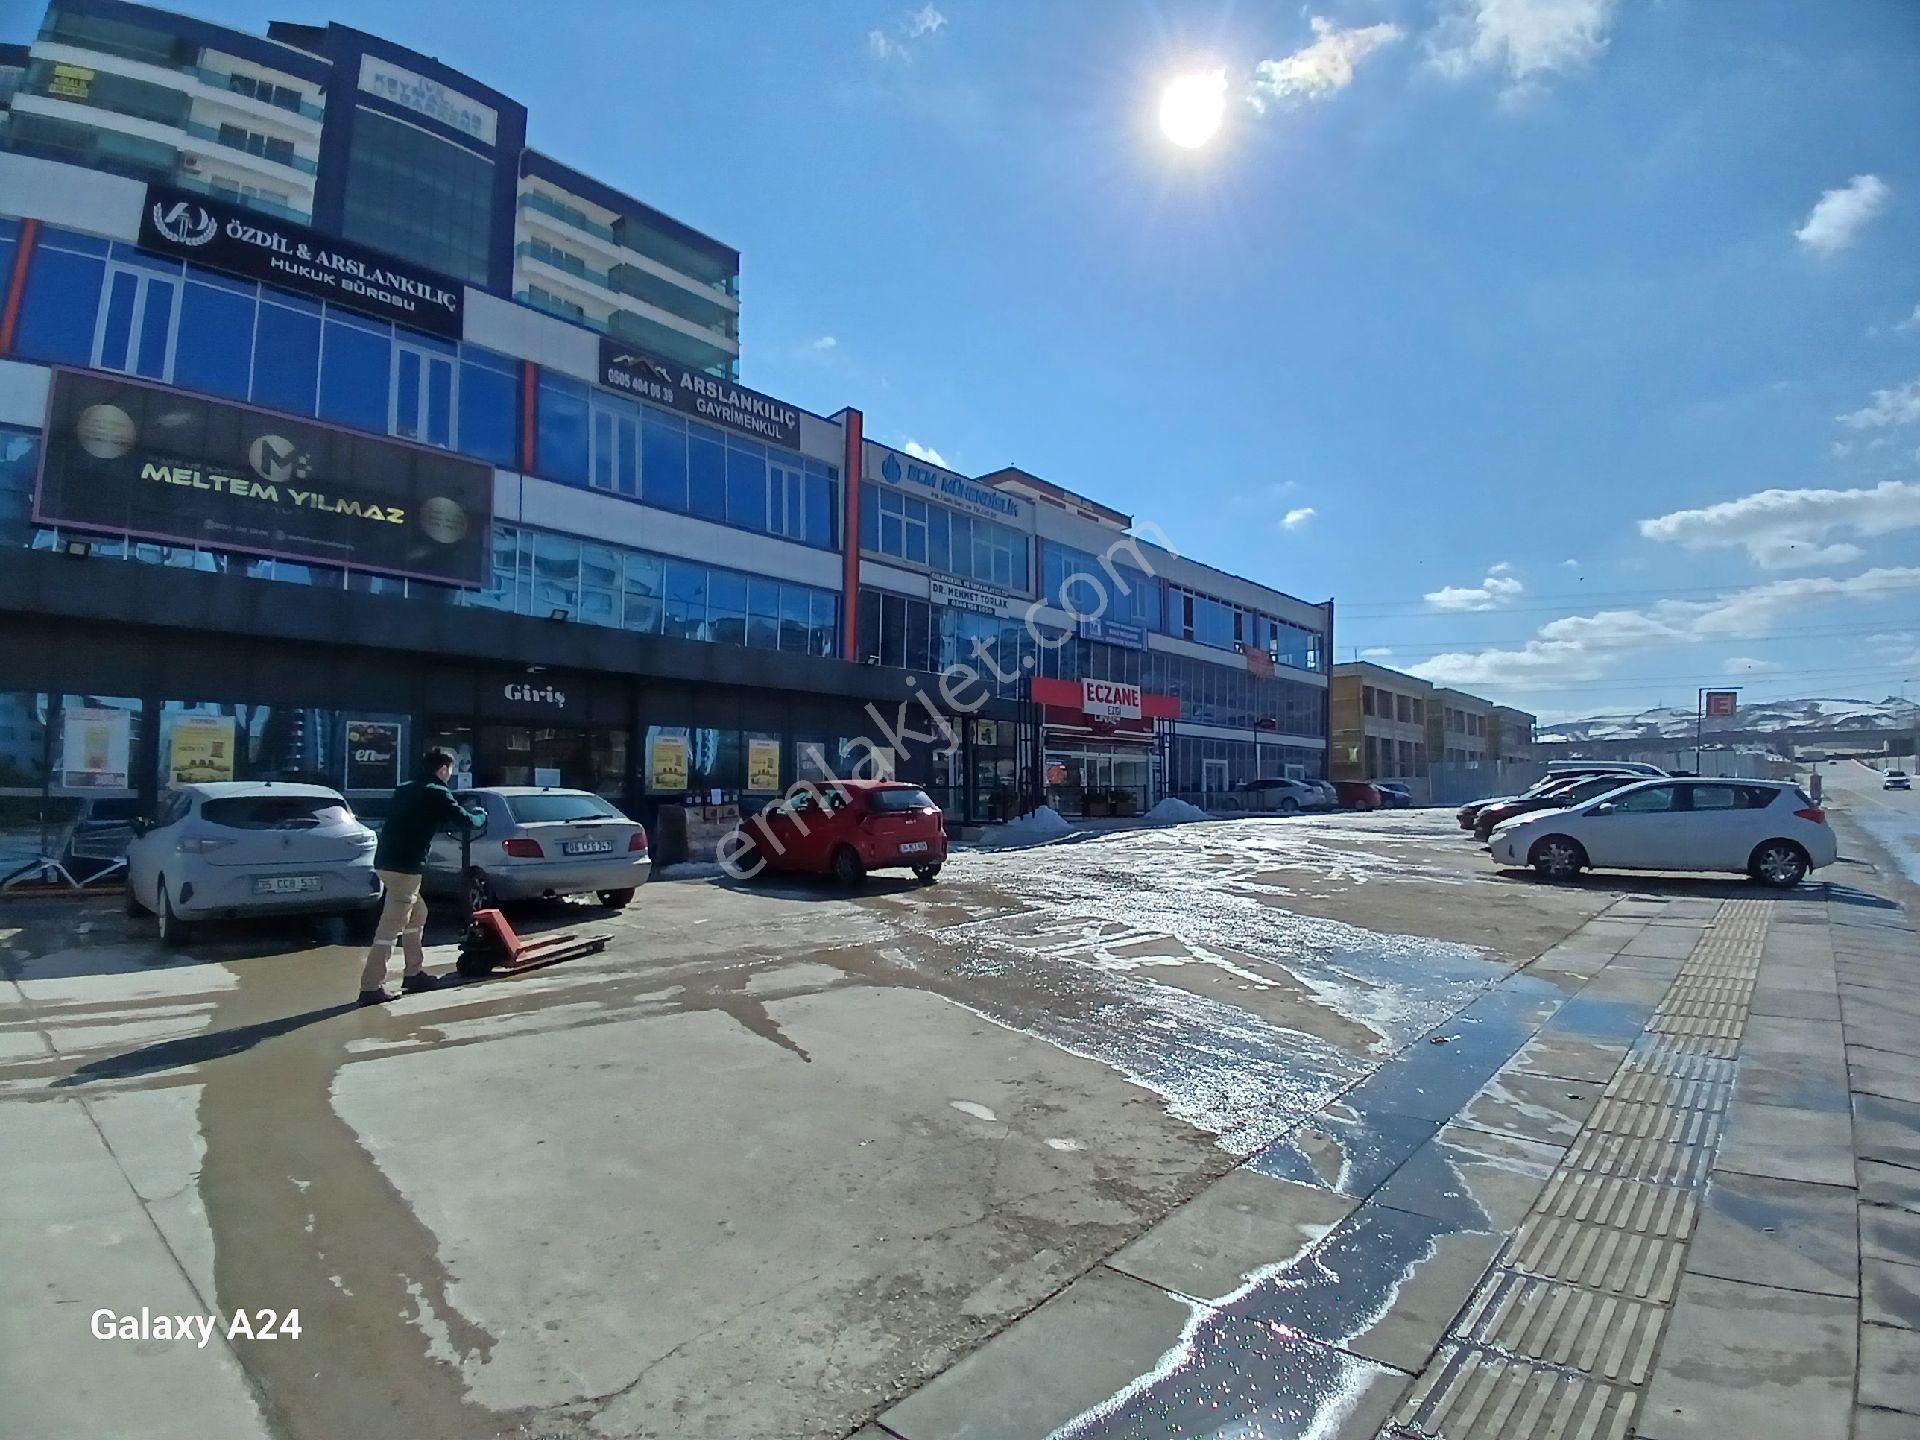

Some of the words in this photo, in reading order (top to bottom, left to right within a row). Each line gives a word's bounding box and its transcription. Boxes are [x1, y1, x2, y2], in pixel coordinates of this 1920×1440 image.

[227, 218, 293, 255] ÖZDİL
[297, 243, 312, 261] &
[315, 252, 458, 313] ARSLANKILIÇ
[271, 257, 335, 285] HUKUK
[342, 279, 416, 312] BÜROSU
[680, 372, 796, 429] ARSLANKILIÇ
[696, 398, 782, 439] GAYRİMENKUL
[141, 463, 279, 502] MELTEM
[288, 488, 405, 524] YILMAZ
[932, 583, 946, 594] DR.
[948, 586, 979, 602] MEHMET
[504, 684, 565, 708] Giriş
[1087, 682, 1139, 707] ECZANE
